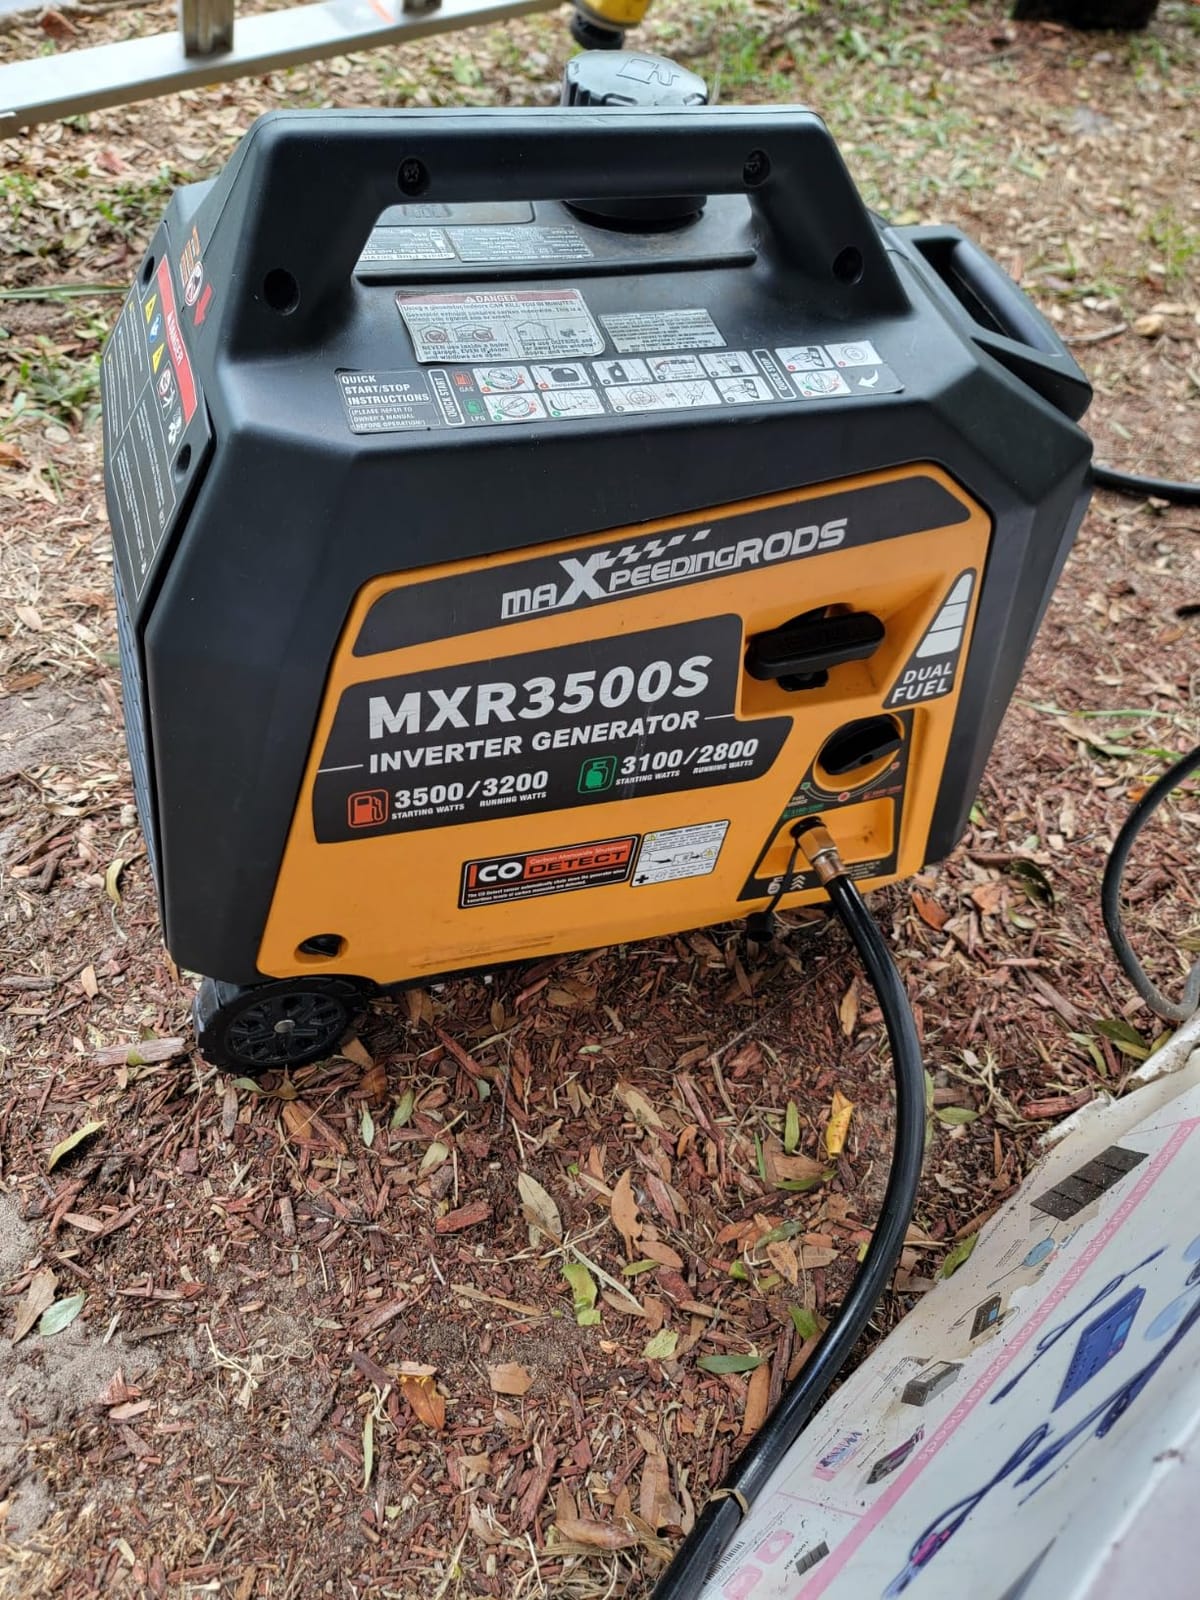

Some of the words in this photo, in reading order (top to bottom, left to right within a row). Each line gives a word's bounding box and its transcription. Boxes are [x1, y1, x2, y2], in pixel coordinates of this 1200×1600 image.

[341, 375, 377, 384] QUICK
[344, 383, 411, 395] START/STOP
[347, 393, 430, 406] INSTRUCTIONS
[470, 413, 486, 422] LPG
[902, 661, 953, 685] DUAL
[368, 655, 713, 740] MXR3500S
[890, 677, 949, 705] FUEL
[369, 734, 523, 775] INVERTER
[531, 710, 700, 751] GENERATOR
[620, 737, 760, 776] 3100/2800
[615, 773, 653, 786] STARTING
[654, 769, 681, 781] WATTS
[728, 759, 754, 770] WATTS
[394, 769, 549, 810] 3500/3200
[391, 807, 434, 820] STARTING
[436, 803, 465, 815] WATTS
[479, 795, 517, 808] RUNNING
[519, 791, 547, 803] WATTS
[477, 861, 524, 883] CO
[528, 850, 627, 875] DETECT
